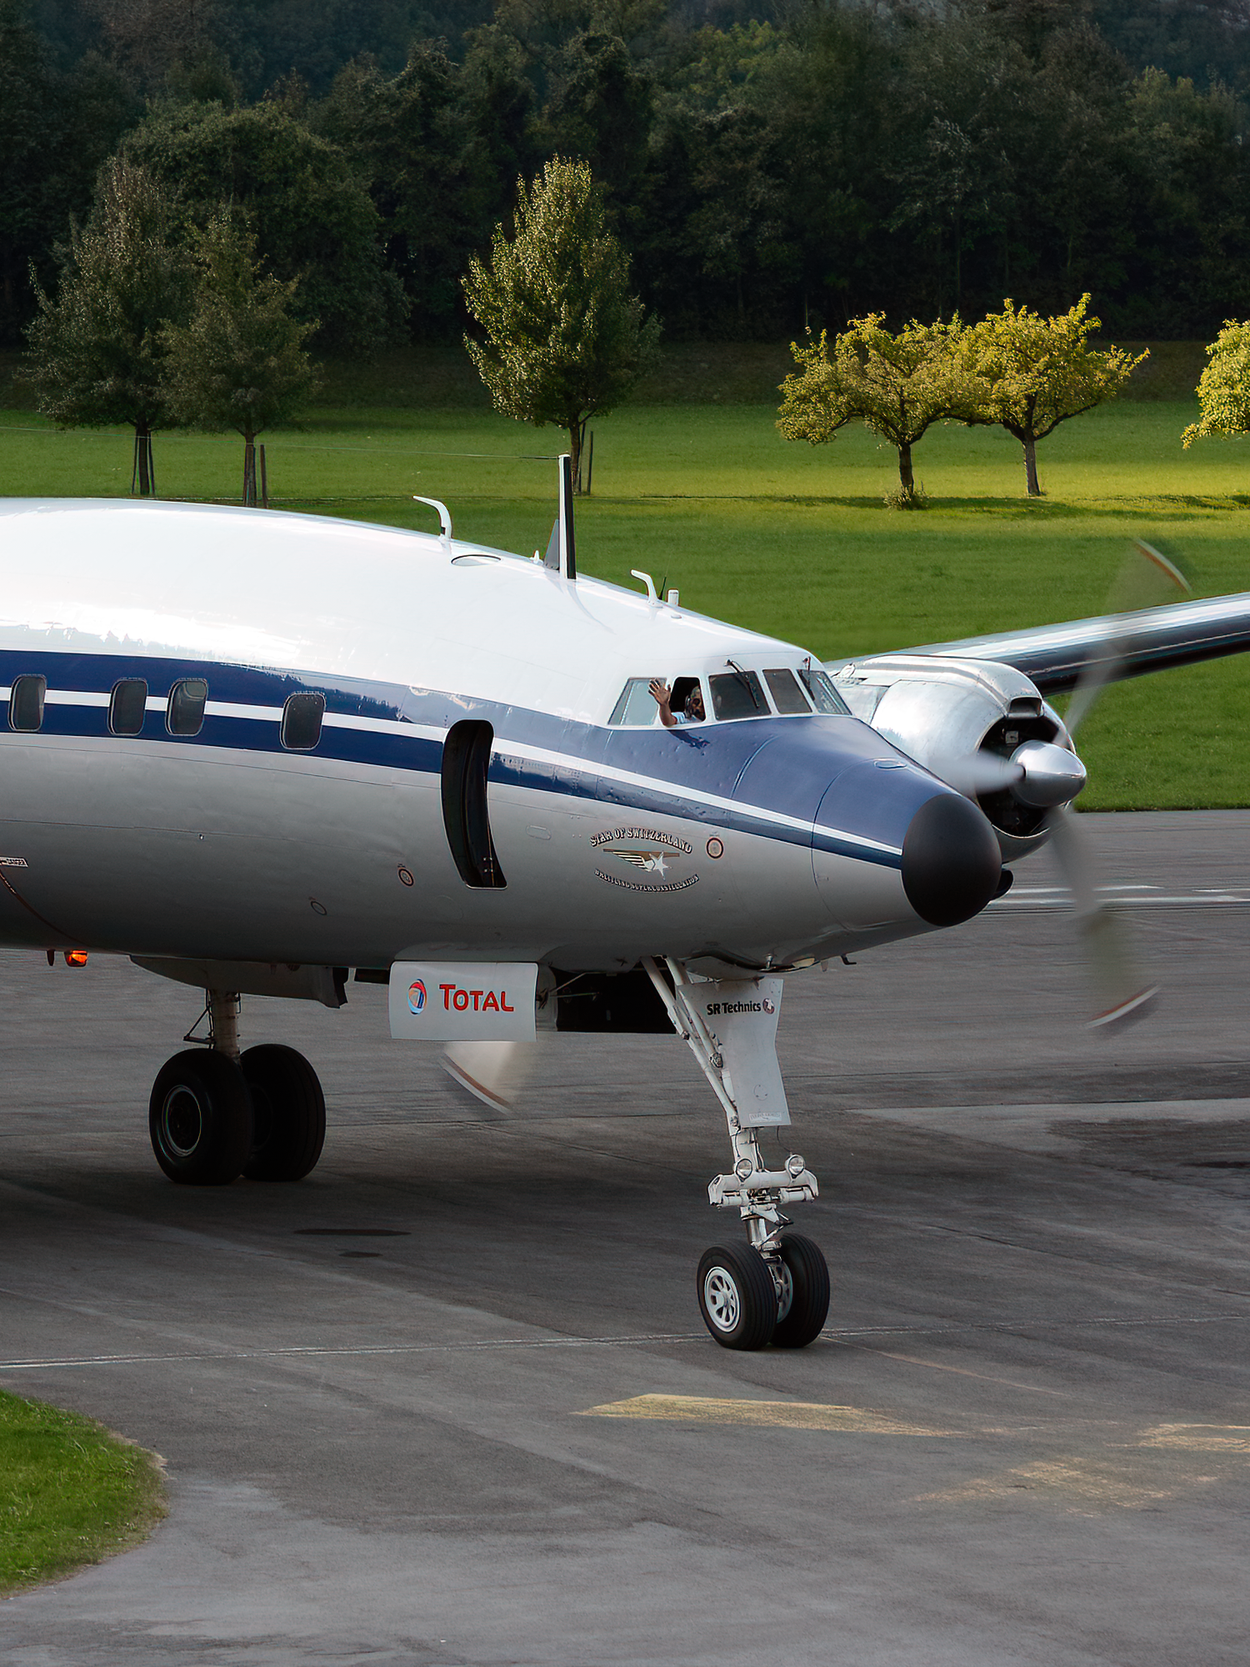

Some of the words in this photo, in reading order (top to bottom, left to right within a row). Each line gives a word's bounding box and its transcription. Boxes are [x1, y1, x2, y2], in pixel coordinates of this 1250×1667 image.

[590, 830, 613, 847] STAR
[614, 827, 626, 839] OF
[627, 827, 692, 854] SWITZERLAND
[439, 984, 514, 1012] TOTAL
[707, 1003, 720, 1015] SR
[722, 1001, 761, 1014] Technics
